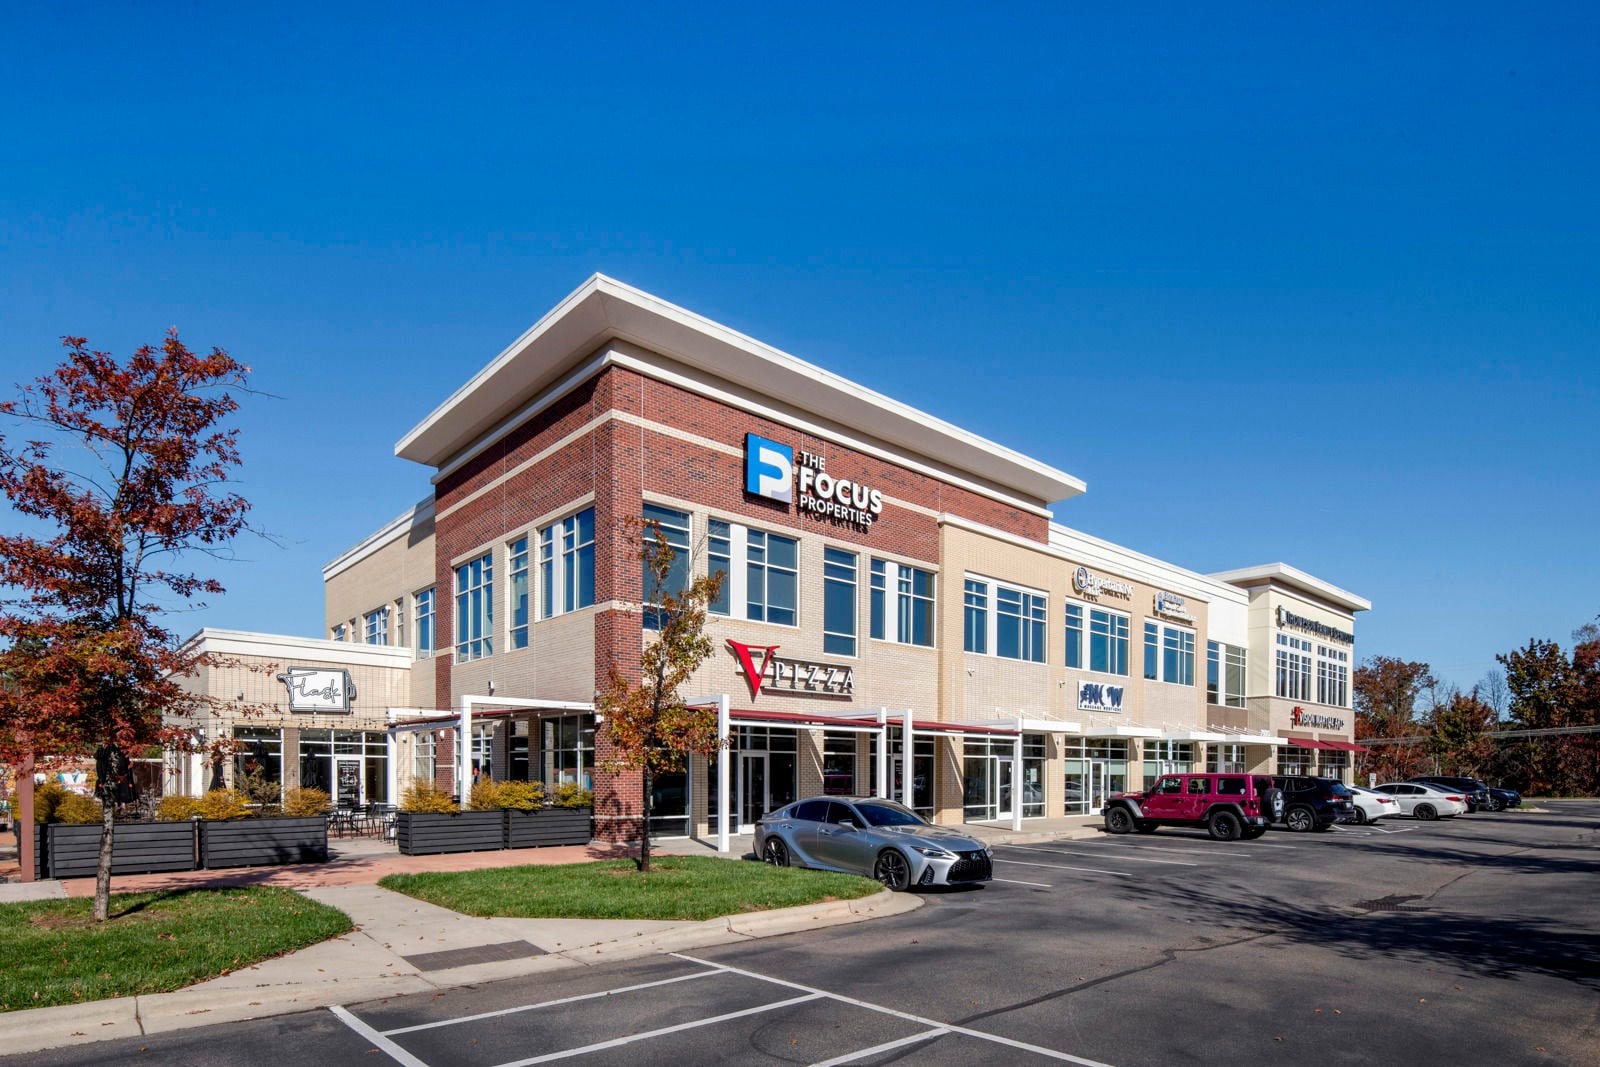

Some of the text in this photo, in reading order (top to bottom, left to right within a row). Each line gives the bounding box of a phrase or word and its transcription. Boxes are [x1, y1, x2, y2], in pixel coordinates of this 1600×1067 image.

[801, 451, 825, 471] THE
[800, 466, 883, 514] FOCUS
[800, 494, 873, 526] PROPERTIES
[725, 639, 855, 696] V PIZZA
[276, 671, 342, 705] Flask
[1299, 712, 1315, 724] VISION
